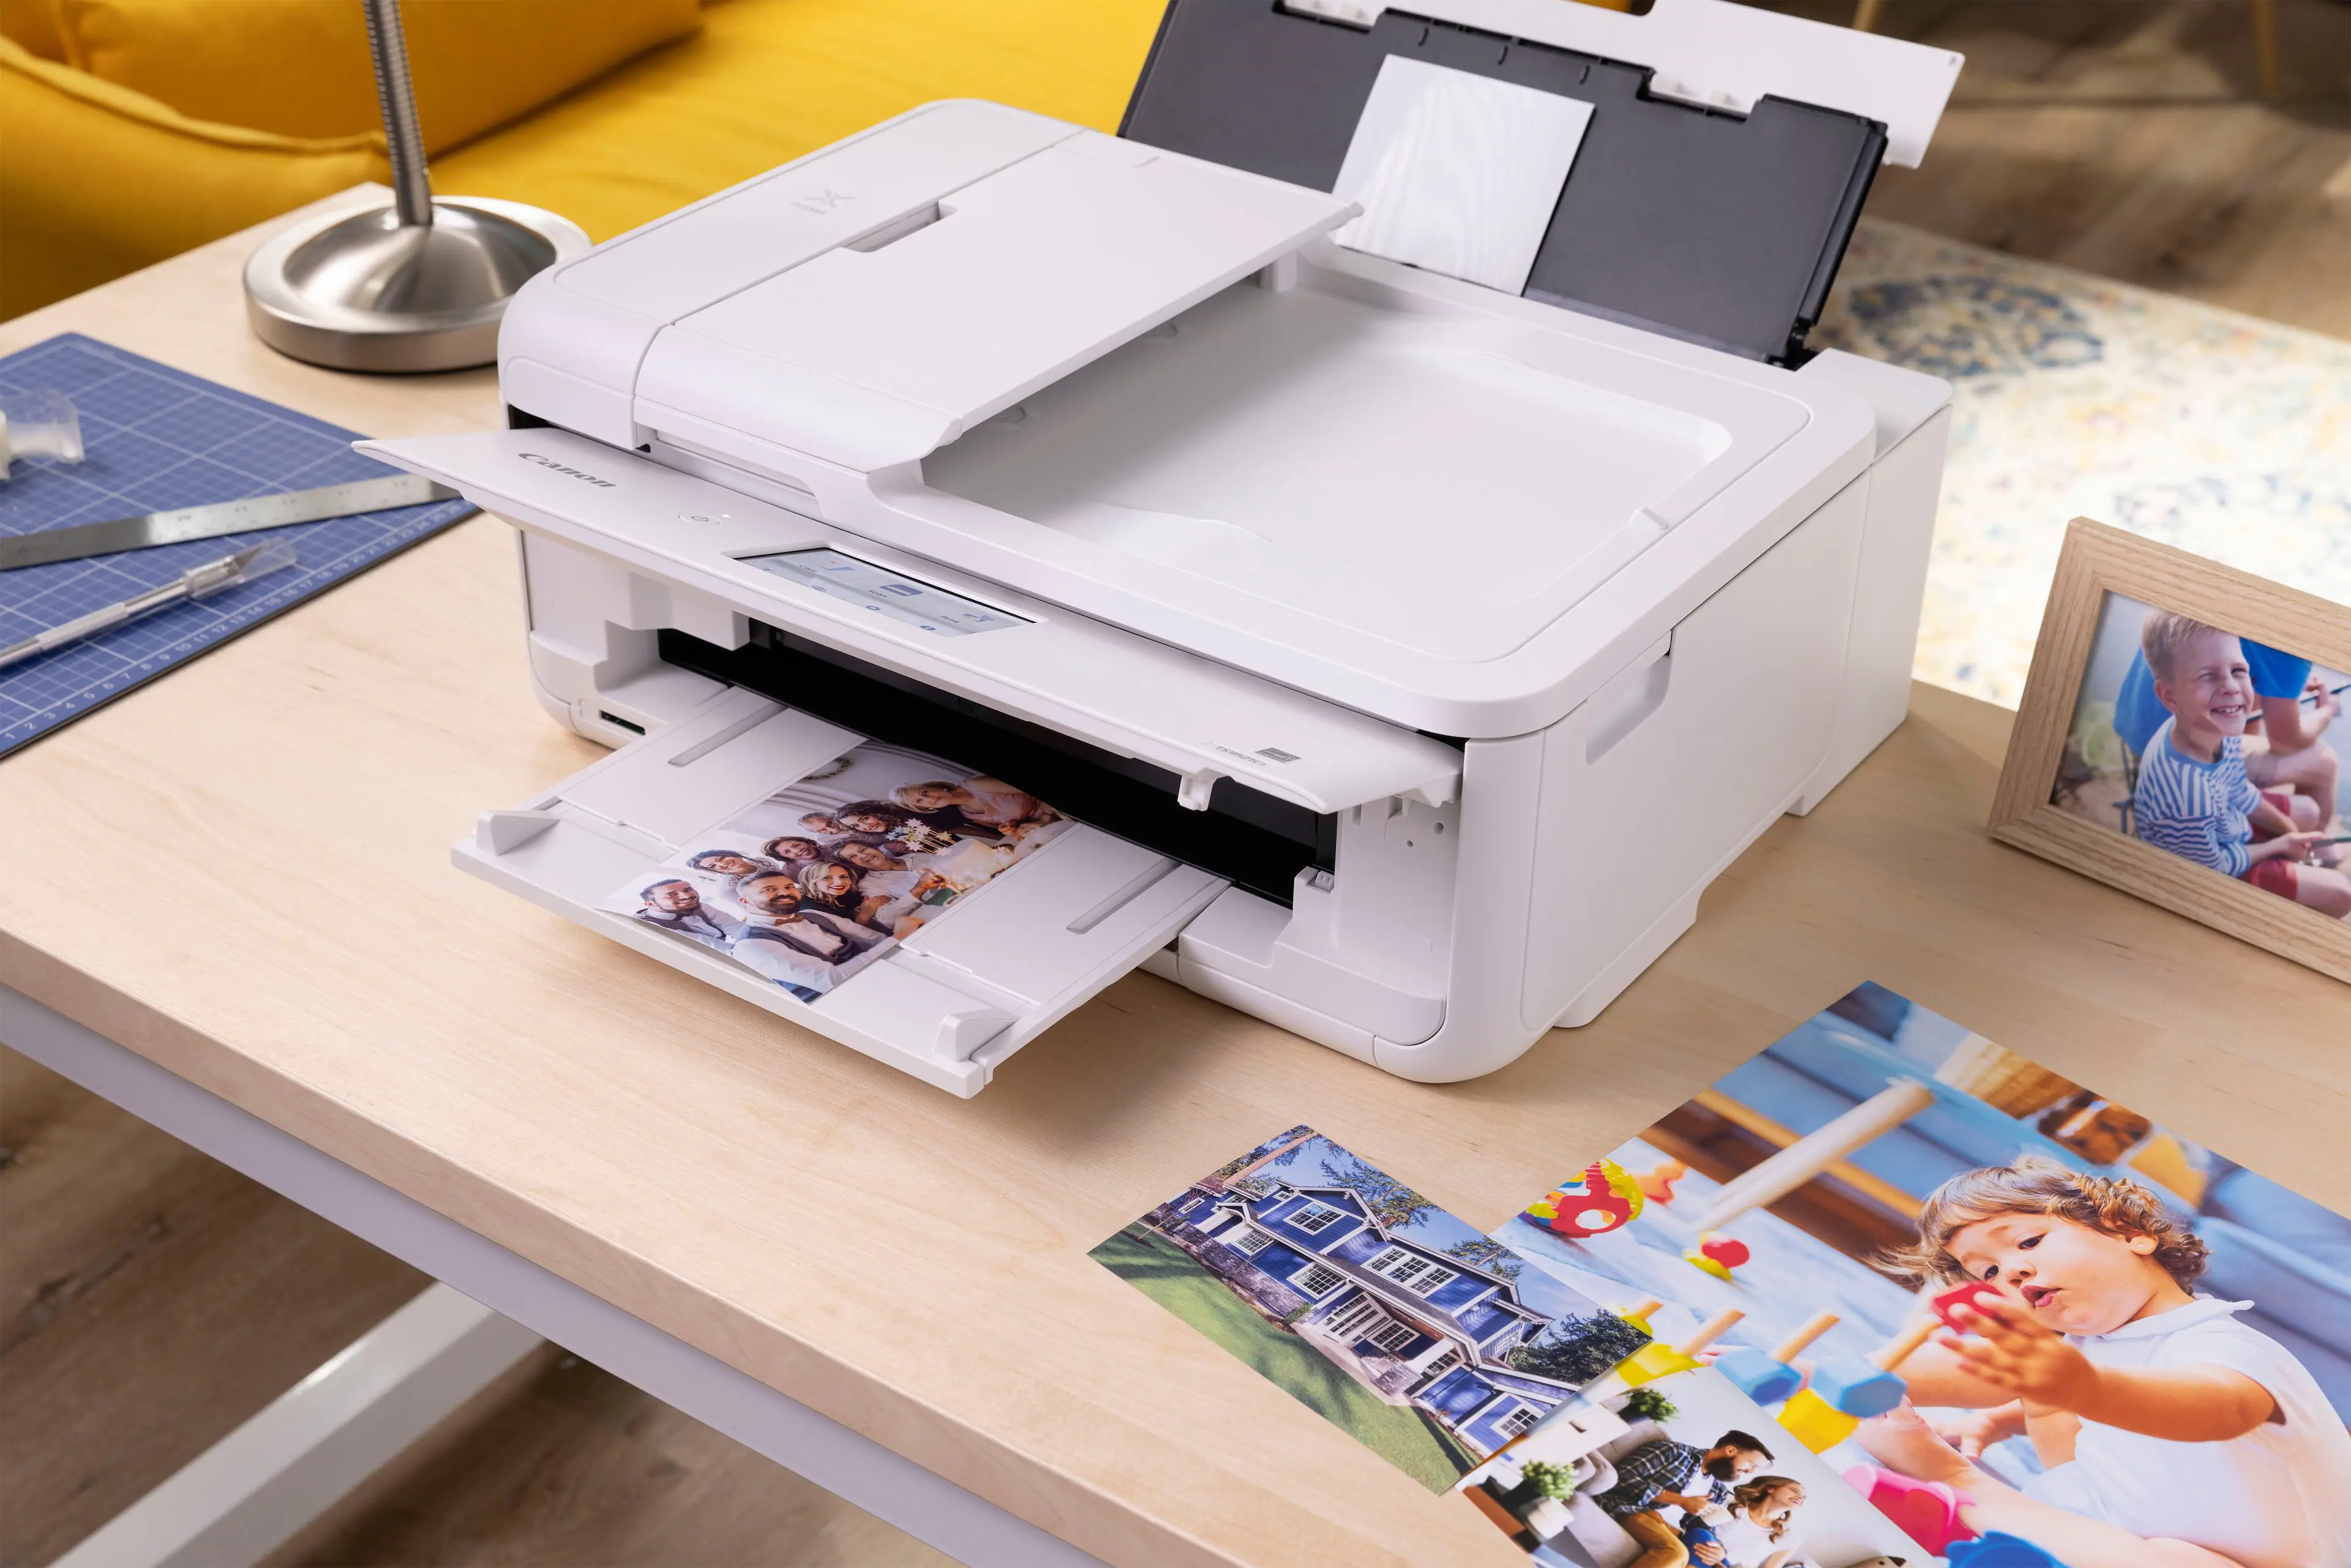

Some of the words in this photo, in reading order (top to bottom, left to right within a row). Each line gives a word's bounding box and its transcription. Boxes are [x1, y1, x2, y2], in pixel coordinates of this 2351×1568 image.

[518, 453, 616, 487] Canon
[174, 642, 192, 652] 10
[193, 633, 209, 643] 11
[211, 623, 228, 633] 12
[228, 615, 246, 625] 13
[246, 606, 263, 615] 14
[281, 588, 299, 598] 16
[299, 579, 313, 588] 17
